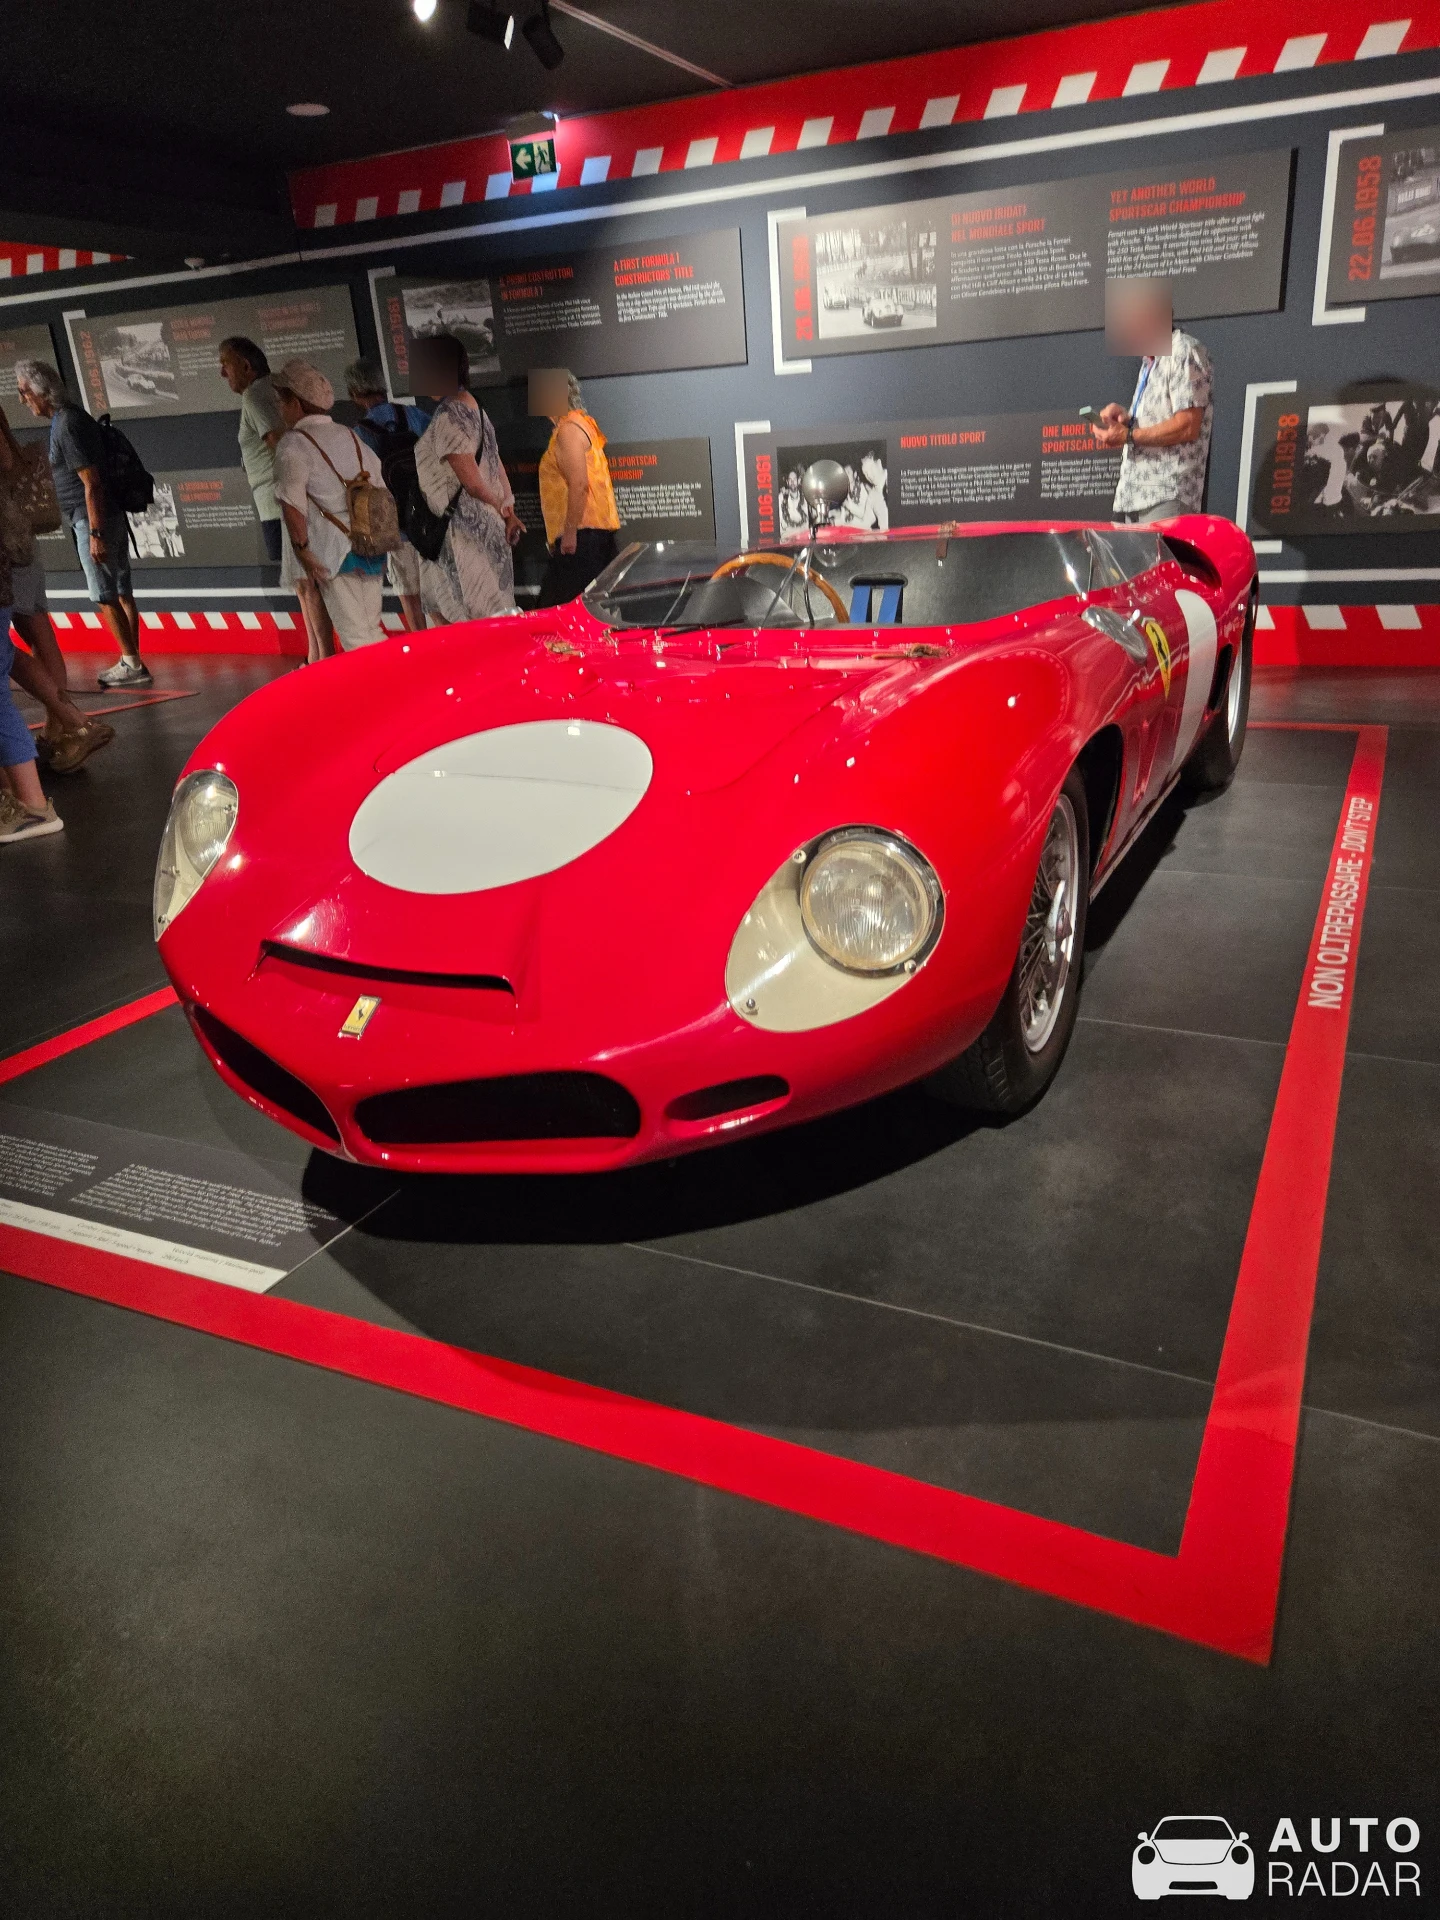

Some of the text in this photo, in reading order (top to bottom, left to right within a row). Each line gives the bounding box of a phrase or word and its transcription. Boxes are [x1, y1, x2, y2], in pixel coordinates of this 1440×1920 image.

[1110, 176, 1216, 203] YET ANOTHER WORLD
[962, 209, 992, 224] NUOVO
[1110, 192, 1246, 222] SPORTSCAR CHAMPIONSHIP
[1348, 155, 1382, 281] 22.06.1958
[969, 223, 1014, 240] MONDIALE
[1016, 218, 1045, 234] SPORT
[614, 260, 619, 272] A
[620, 257, 640, 271] FIRST
[642, 253, 675, 268] FORMULA
[615, 266, 693, 286] CONSTRUCTORS' TITLE
[900, 430, 986, 448] NUOVO TITOLO SPORT
[1042, 425, 1059, 438] ONE
[1062, 423, 1086, 436] MORE
[1042, 438, 1093, 454] SPORTSCAR
[618, 455, 657, 467] SPORTSCAR
[1270, 414, 1299, 514] 19.10.1958
[756, 455, 774, 534] 11.06.1961
[1308, 797, 1372, 1009] NON OLTREPASSARE DON'T STEP
